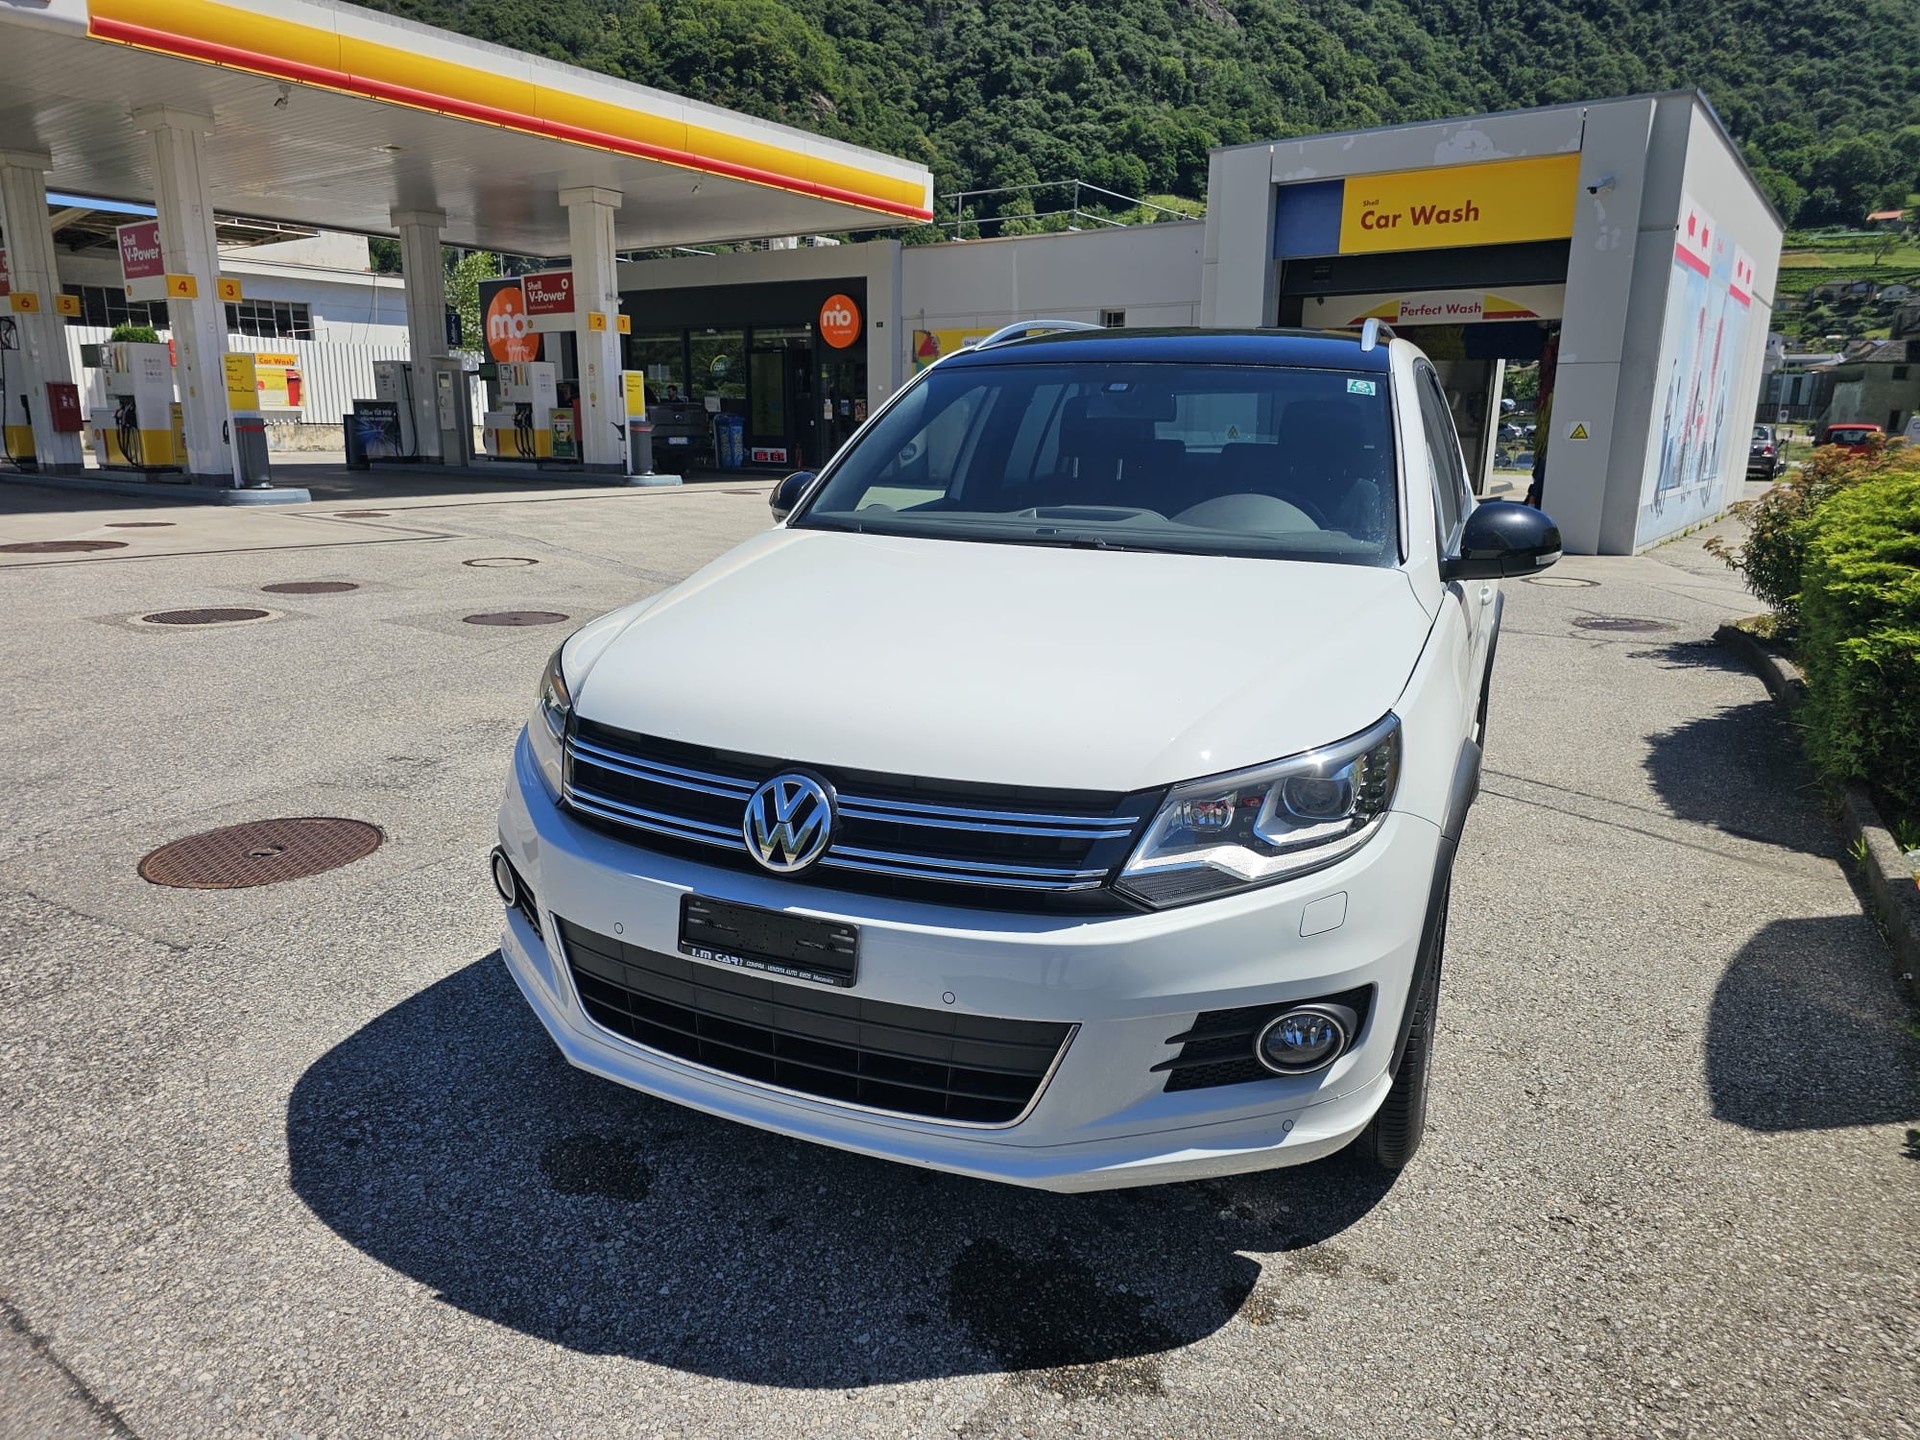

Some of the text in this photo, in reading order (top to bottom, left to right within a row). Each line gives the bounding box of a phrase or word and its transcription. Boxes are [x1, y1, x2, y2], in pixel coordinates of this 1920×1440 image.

[1362, 199, 1379, 207] Shell
[1360, 200, 1480, 230] Car Wash
[122, 233, 136, 246] Shell
[124, 247, 159, 262] V-Power
[178, 281, 188, 293] 4
[226, 284, 235, 296] 3
[527, 280, 542, 291] Shell
[528, 289, 567, 303] V-Power
[21, 298, 30, 308] 6
[64, 300, 71, 310] 5
[1400, 302, 1482, 316] Perfect Wash
[490, 303, 527, 339] mio
[823, 303, 851, 327] mio
[596, 317, 602, 326] 2
[621, 319, 626, 328] 1
[258, 357, 271, 365] Car
